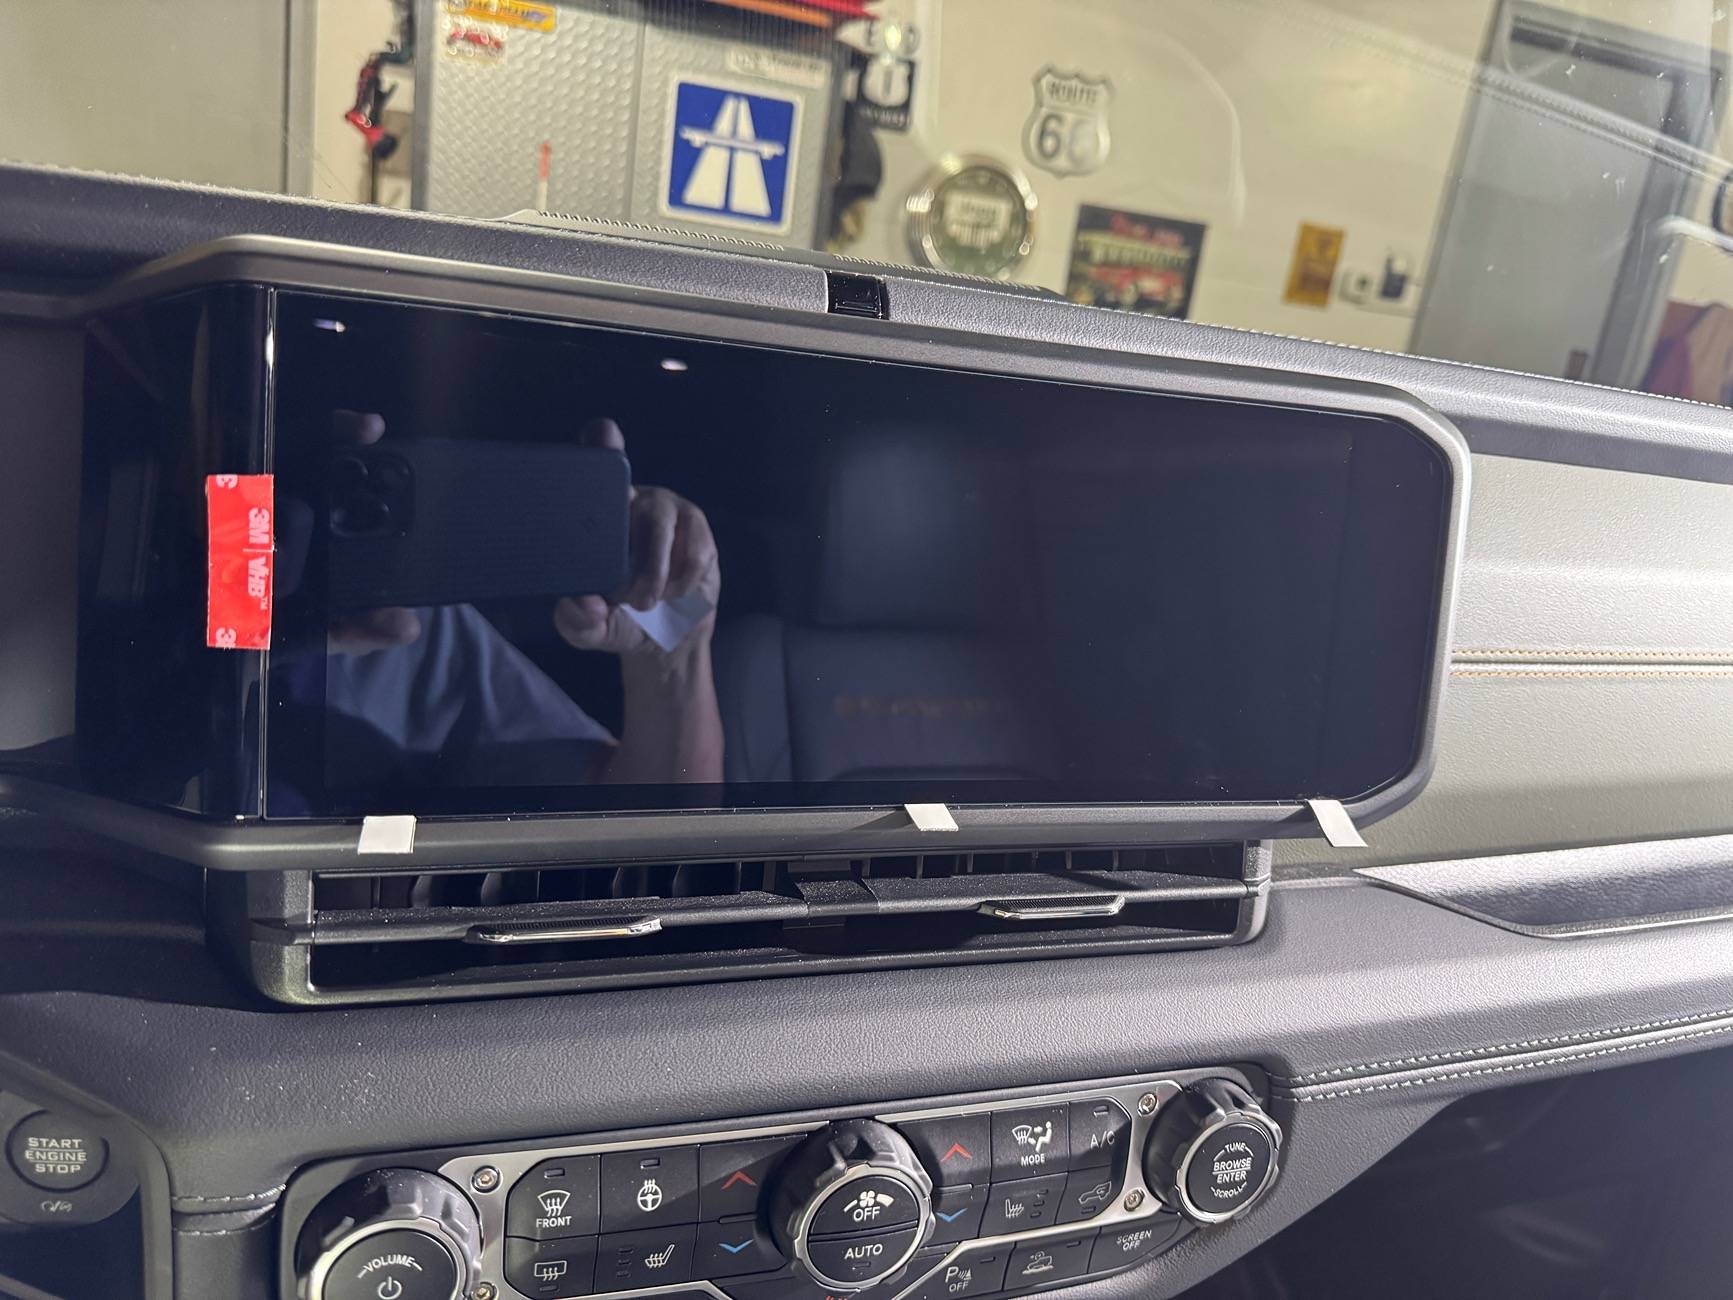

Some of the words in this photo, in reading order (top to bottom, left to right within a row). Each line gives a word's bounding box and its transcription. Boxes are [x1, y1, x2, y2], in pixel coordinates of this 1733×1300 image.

[249, 507, 270, 544] 3M
[215, 627, 237, 648] 3
[28, 1136, 83, 1149] START
[1090, 1130, 1116, 1149] A/C
[1224, 1141, 1247, 1153] TUNE
[24, 1149, 88, 1162] ENGINE
[1020, 1153, 1046, 1167] MODE
[35, 1163, 81, 1174] STOP
[1213, 1157, 1252, 1171] BROWSE
[1216, 1170, 1248, 1184] ENTER
[1213, 1185, 1244, 1199] SCROLL
[853, 1206, 881, 1222] OFF
[535, 1215, 572, 1228] FRONT
[1116, 1229, 1152, 1245] SCREEN
[844, 1243, 884, 1260] AUTO
[1122, 1239, 1141, 1251] OFF
[362, 1253, 416, 1273] VOLUME
[948, 1281, 969, 1292] OFF
